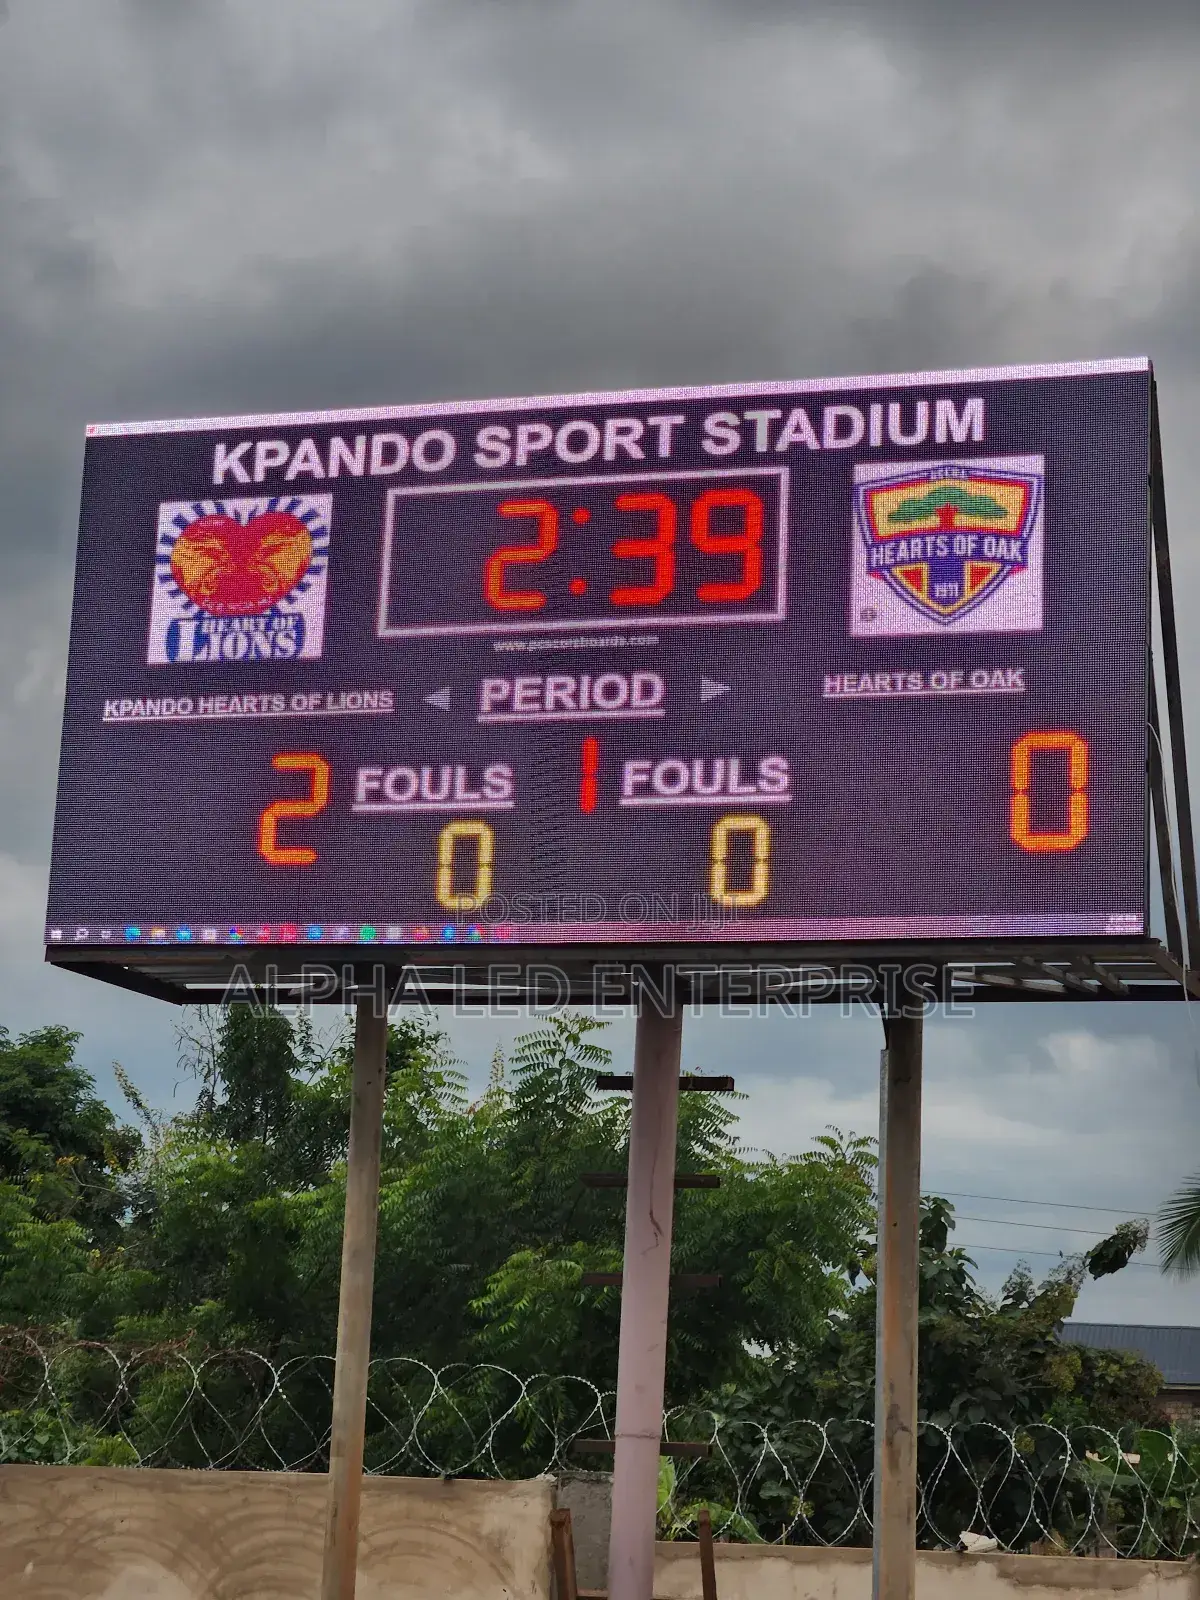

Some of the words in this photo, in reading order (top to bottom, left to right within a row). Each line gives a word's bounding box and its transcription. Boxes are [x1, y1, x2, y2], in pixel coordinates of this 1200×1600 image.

[212, 428, 456, 485] KPANDO
[474, 414, 685, 470] SPORT
[701, 398, 985, 456] STADIUM
[484, 487, 763, 611] 2:39
[871, 535, 949, 567] HEARTS
[953, 535, 979, 557] OF
[984, 537, 1022, 562] OAK
[177, 619, 298, 662] LIONS
[202, 617, 268, 634] HEART
[272, 616, 299, 632] OF
[481, 671, 667, 713] PERIOD
[824, 673, 923, 693] HEARTS
[930, 671, 964, 690] OF
[972, 668, 1025, 689] OAK
[104, 698, 194, 718] KPANDO
[199, 693, 286, 714] HEARTS
[291, 693, 322, 711] OF
[327, 690, 395, 709] LIONS
[355, 763, 516, 802] FOULS
[621, 756, 790, 797] FOULS
[1010, 730, 1090, 852] 0
[257, 752, 331, 866] 2
[435, 818, 495, 910] 0
[709, 813, 772, 907] 0
